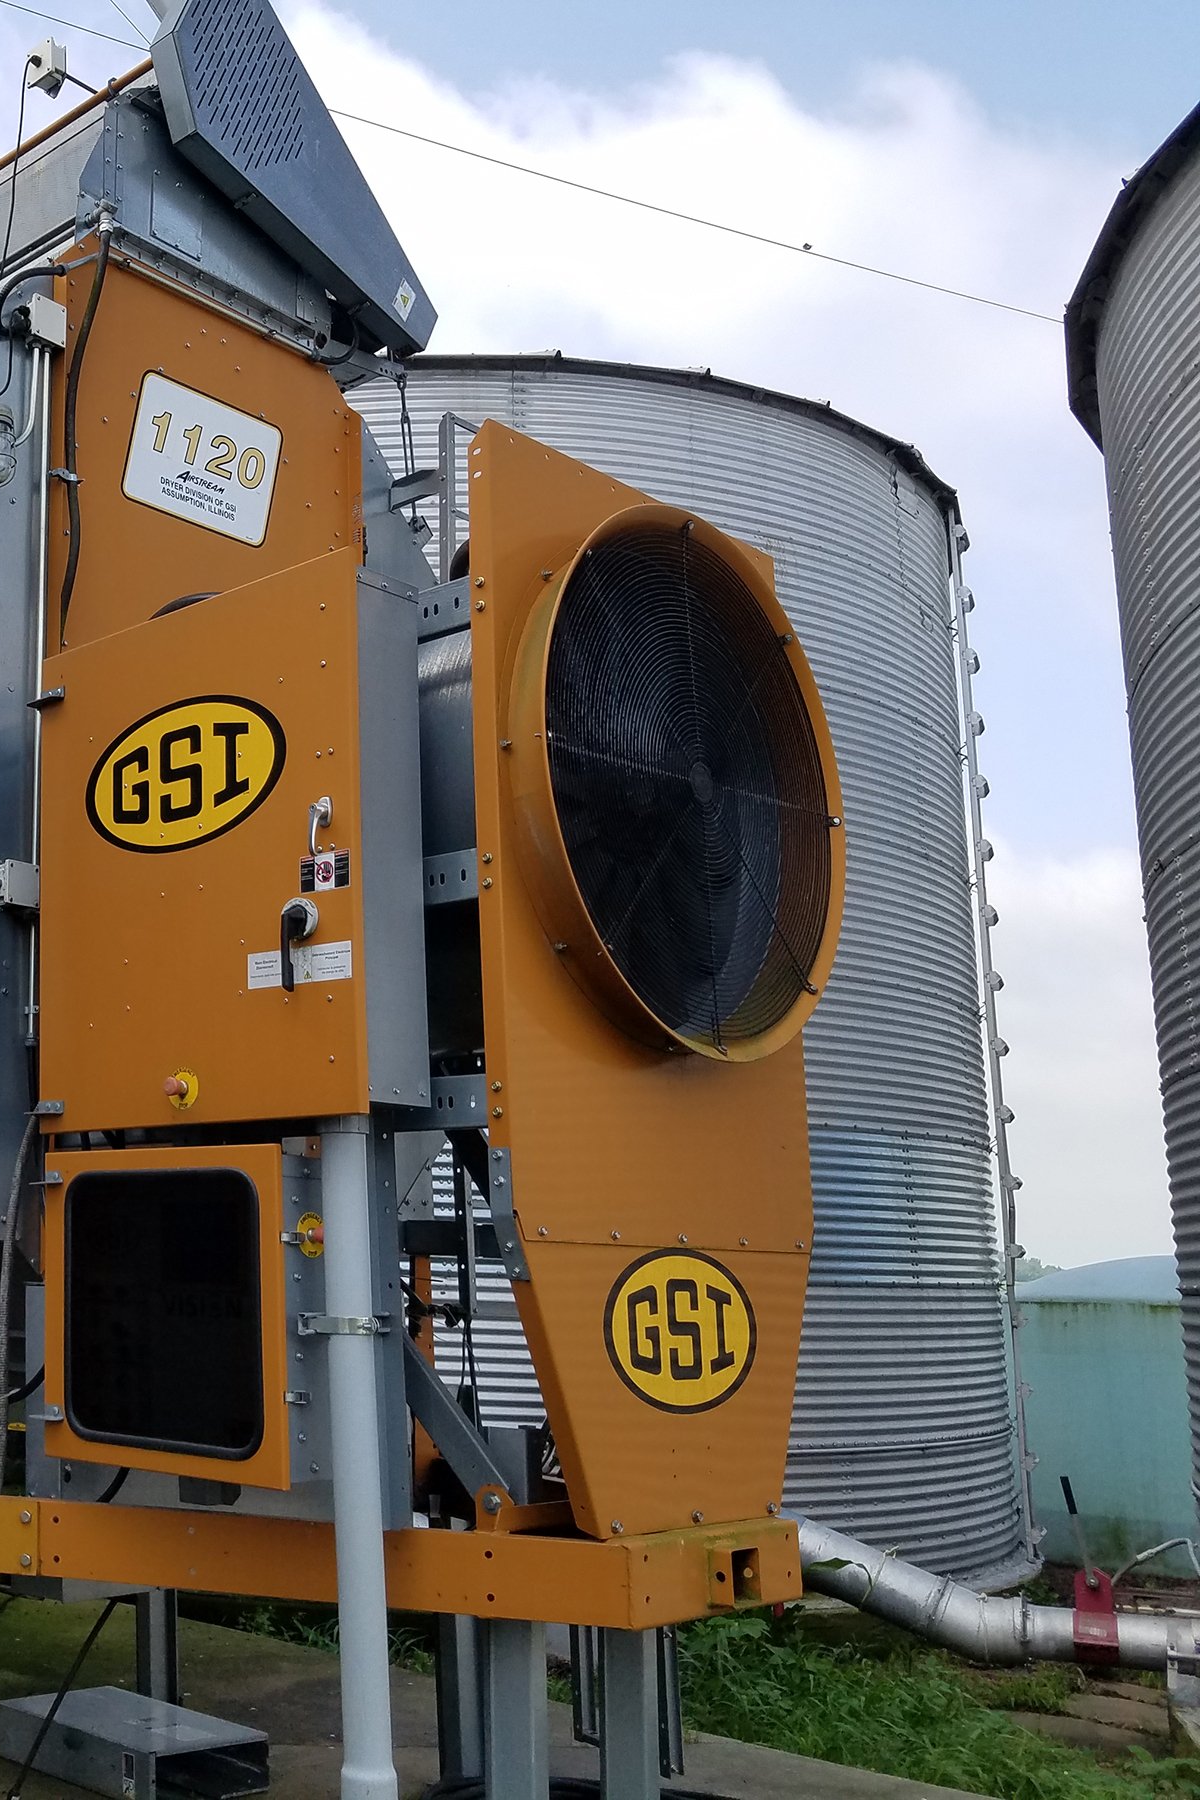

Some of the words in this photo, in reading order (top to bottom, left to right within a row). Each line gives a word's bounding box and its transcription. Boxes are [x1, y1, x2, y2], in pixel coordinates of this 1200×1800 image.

[151, 410, 266, 490] 1120
[160, 476, 184, 493] DRYER
[184, 484, 214, 504] DIVISION
[214, 497, 224, 507] OF
[224, 500, 237, 513] GSI
[161, 487, 207, 511] ASSUMPTION,
[207, 504, 236, 522] ILLINOIS
[176, 470, 226, 495] AIRSTREAM
[112, 722, 249, 824] GSI
[626, 1278, 735, 1380] GSI
